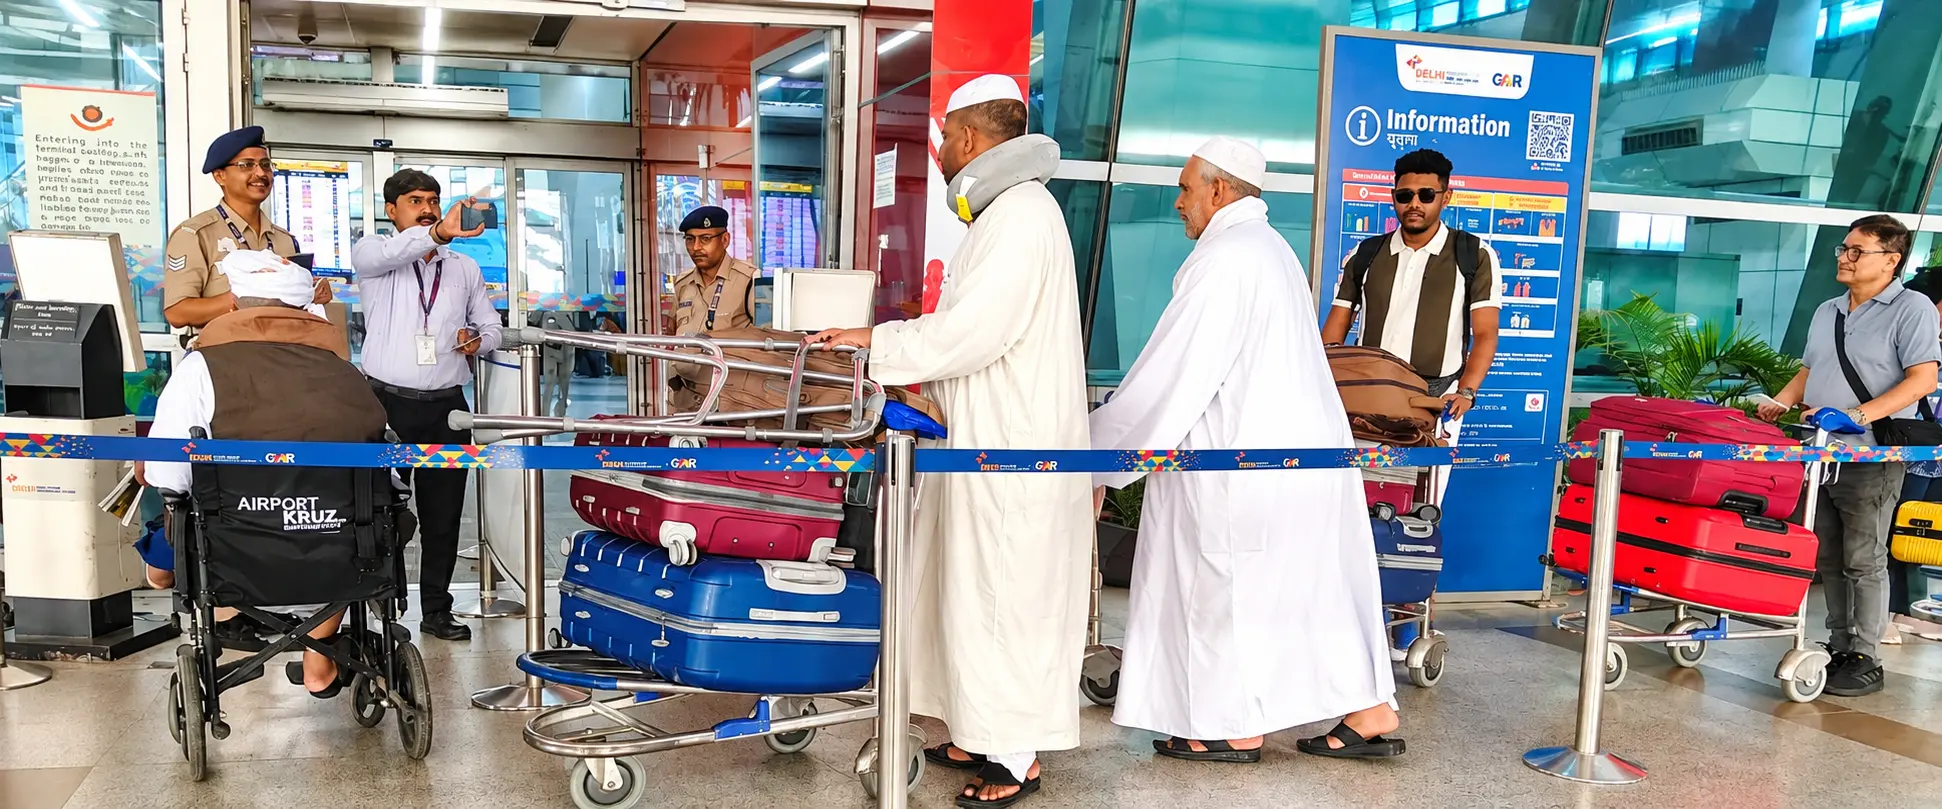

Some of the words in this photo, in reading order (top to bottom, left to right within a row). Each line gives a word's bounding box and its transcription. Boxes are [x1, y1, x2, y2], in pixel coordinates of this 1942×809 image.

[1415, 68, 1445, 81] DELHI
[1386, 108, 1511, 138] Information
[35, 134, 86, 147] Entering
[97, 138, 120, 148] into
[130, 141, 148, 149] the
[237, 496, 320, 511] AIRPORT
[283, 509, 338, 524] KRUZ
